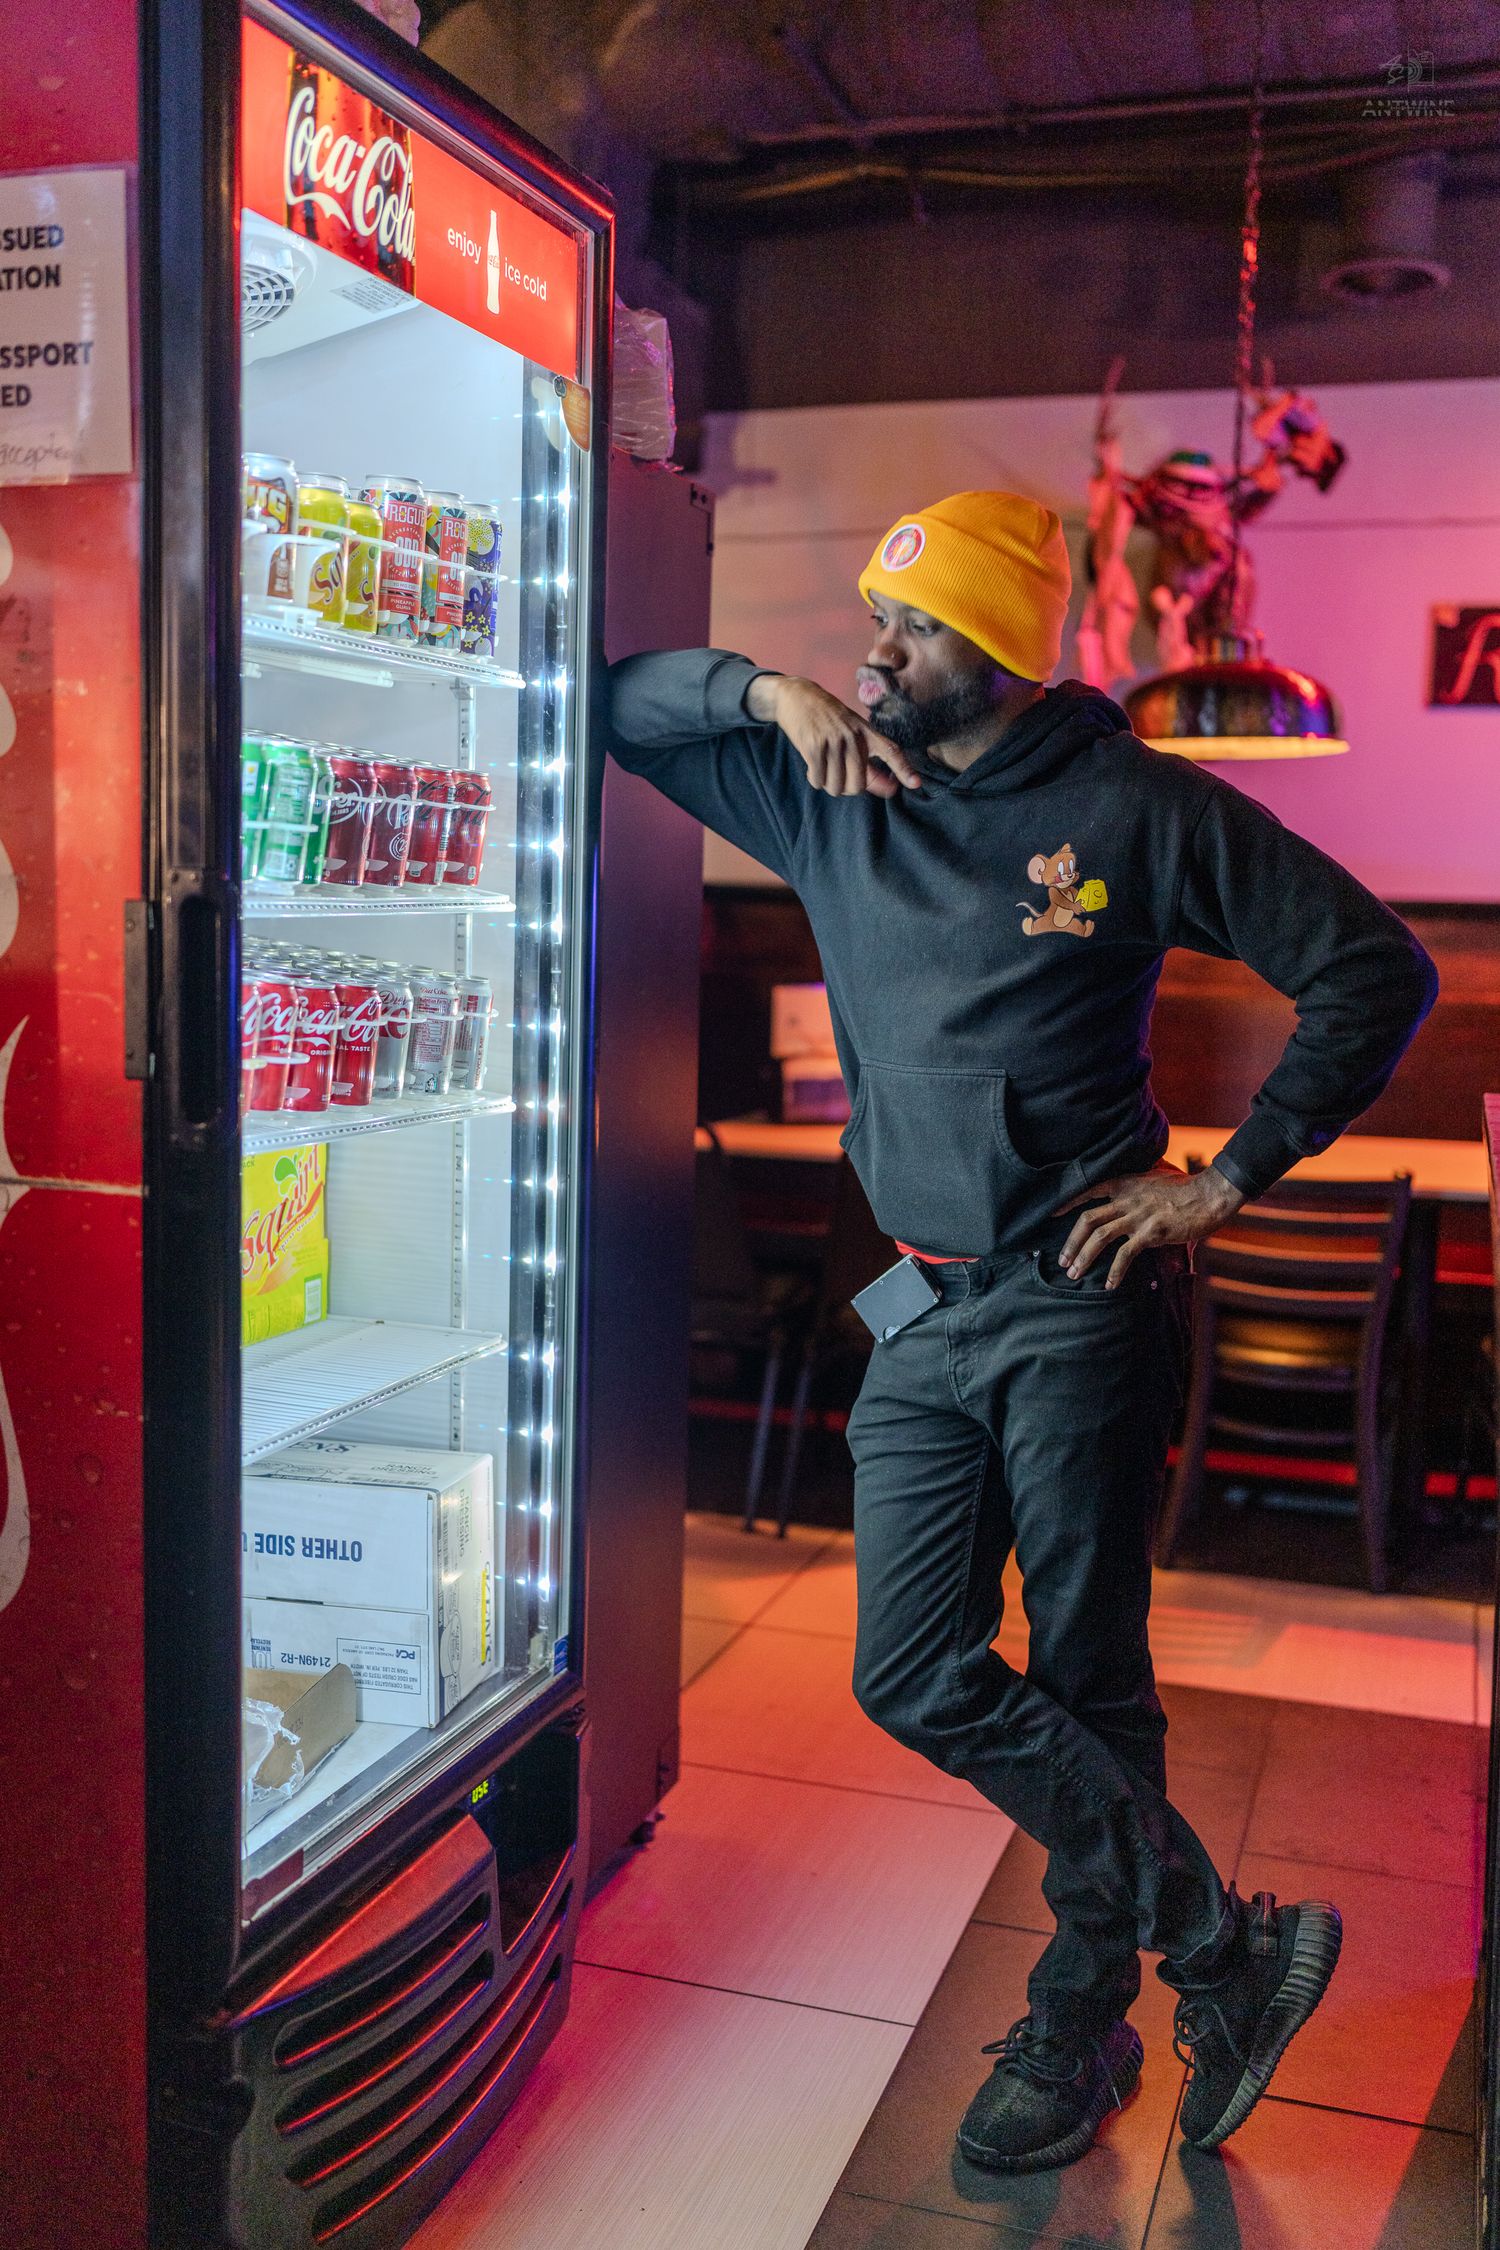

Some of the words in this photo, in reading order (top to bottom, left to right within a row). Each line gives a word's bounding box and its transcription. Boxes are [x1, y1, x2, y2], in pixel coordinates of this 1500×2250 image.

[284, 86, 415, 262] Coca-Cola
[447, 228, 482, 264] enjoy
[504, 257, 521, 285] ice
[523, 273, 548, 301] cold
[387, 504, 428, 529] ROGUE
[351, 1045, 371, 1053] TASTE
[242, 1144, 320, 1277] Squirt
[254, 1532, 295, 1557] SIDE
[301, 1537, 363, 1562] OTHER
[280, 1652, 331, 1668] 2149N-R2
[395, 1648, 416, 1660] PCA
